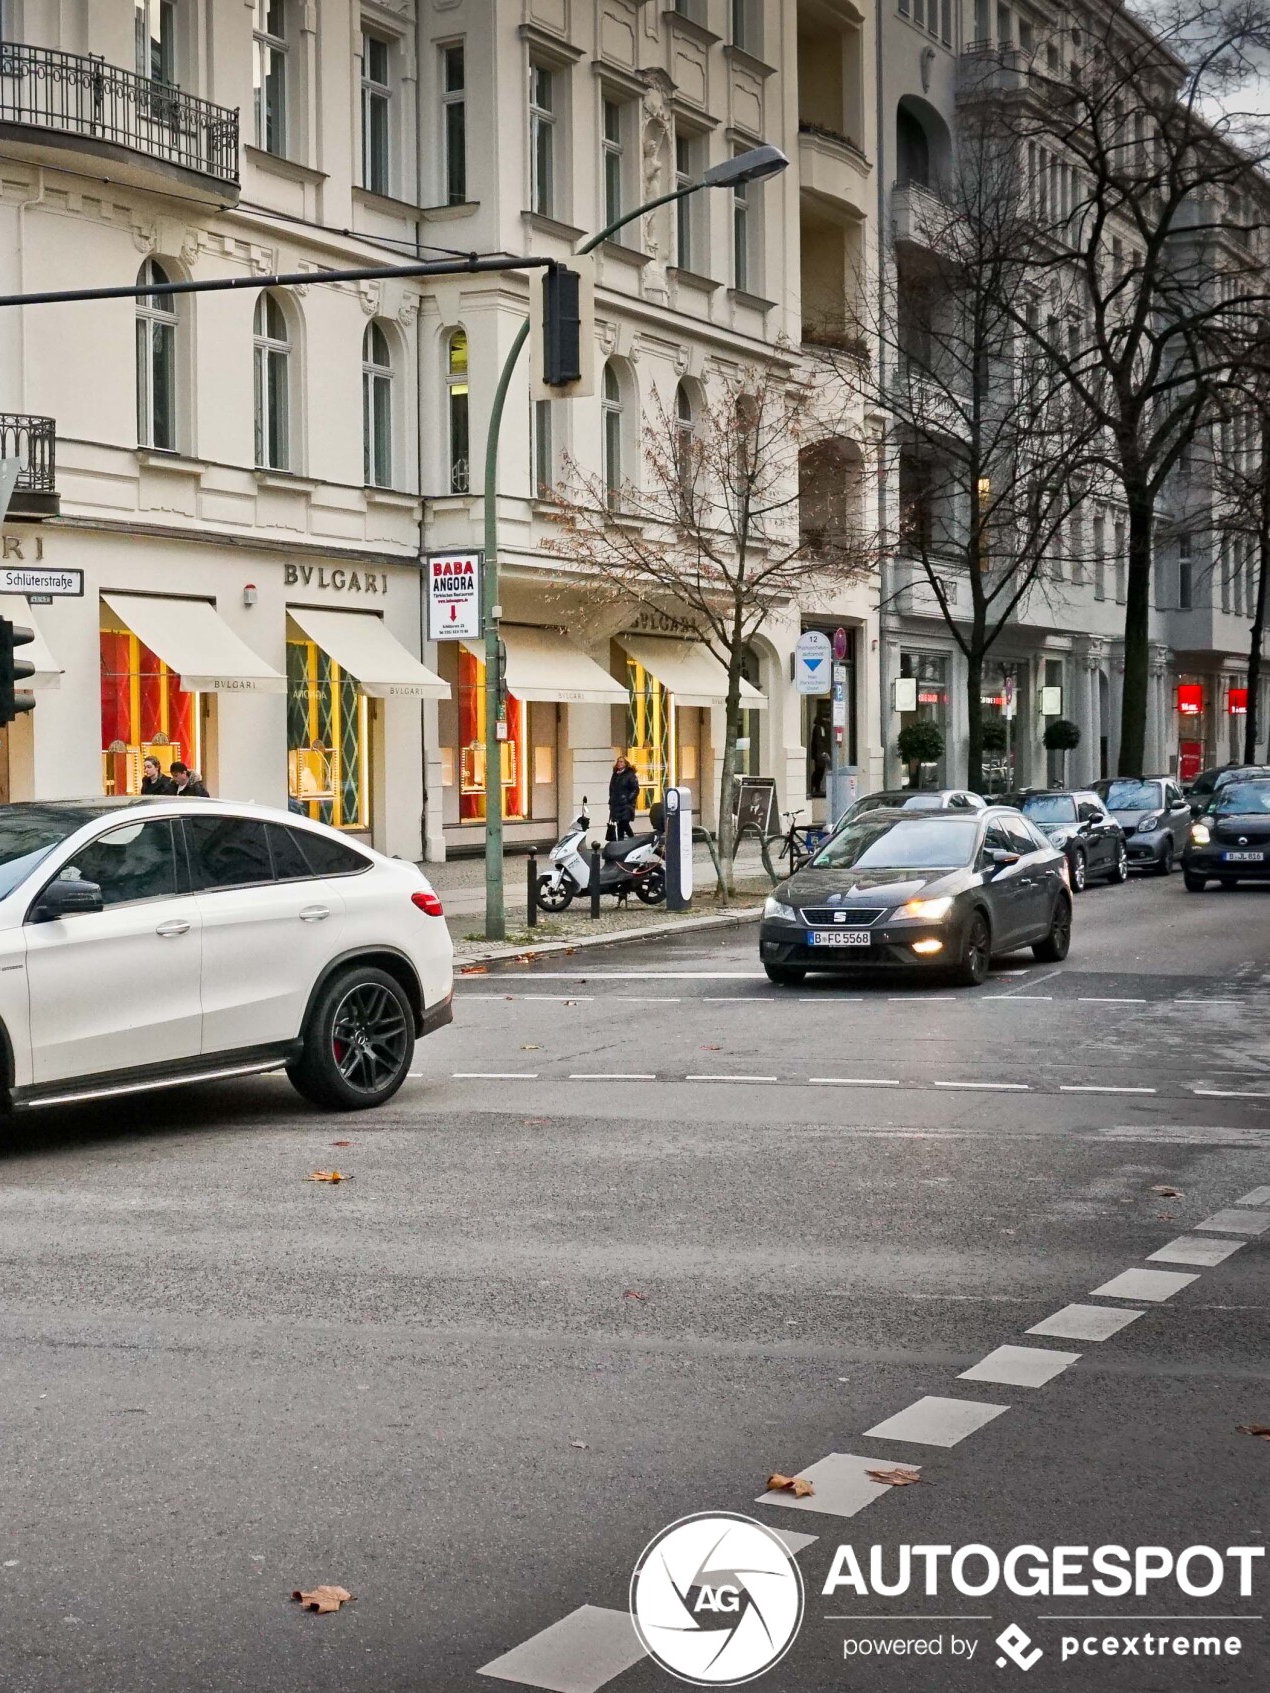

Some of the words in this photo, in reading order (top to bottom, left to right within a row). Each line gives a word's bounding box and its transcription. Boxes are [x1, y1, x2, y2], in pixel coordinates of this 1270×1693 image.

[433, 561, 474, 576] BABA
[6, 573, 73, 590] Schlüterstraße
[284, 563, 388, 594] BVLGARI
[433, 576, 474, 591] ANGORA
[214, 680, 257, 690] BVLGARI
[389, 686, 424, 696] BVLGARI
[842, 933, 869, 944] 5568
